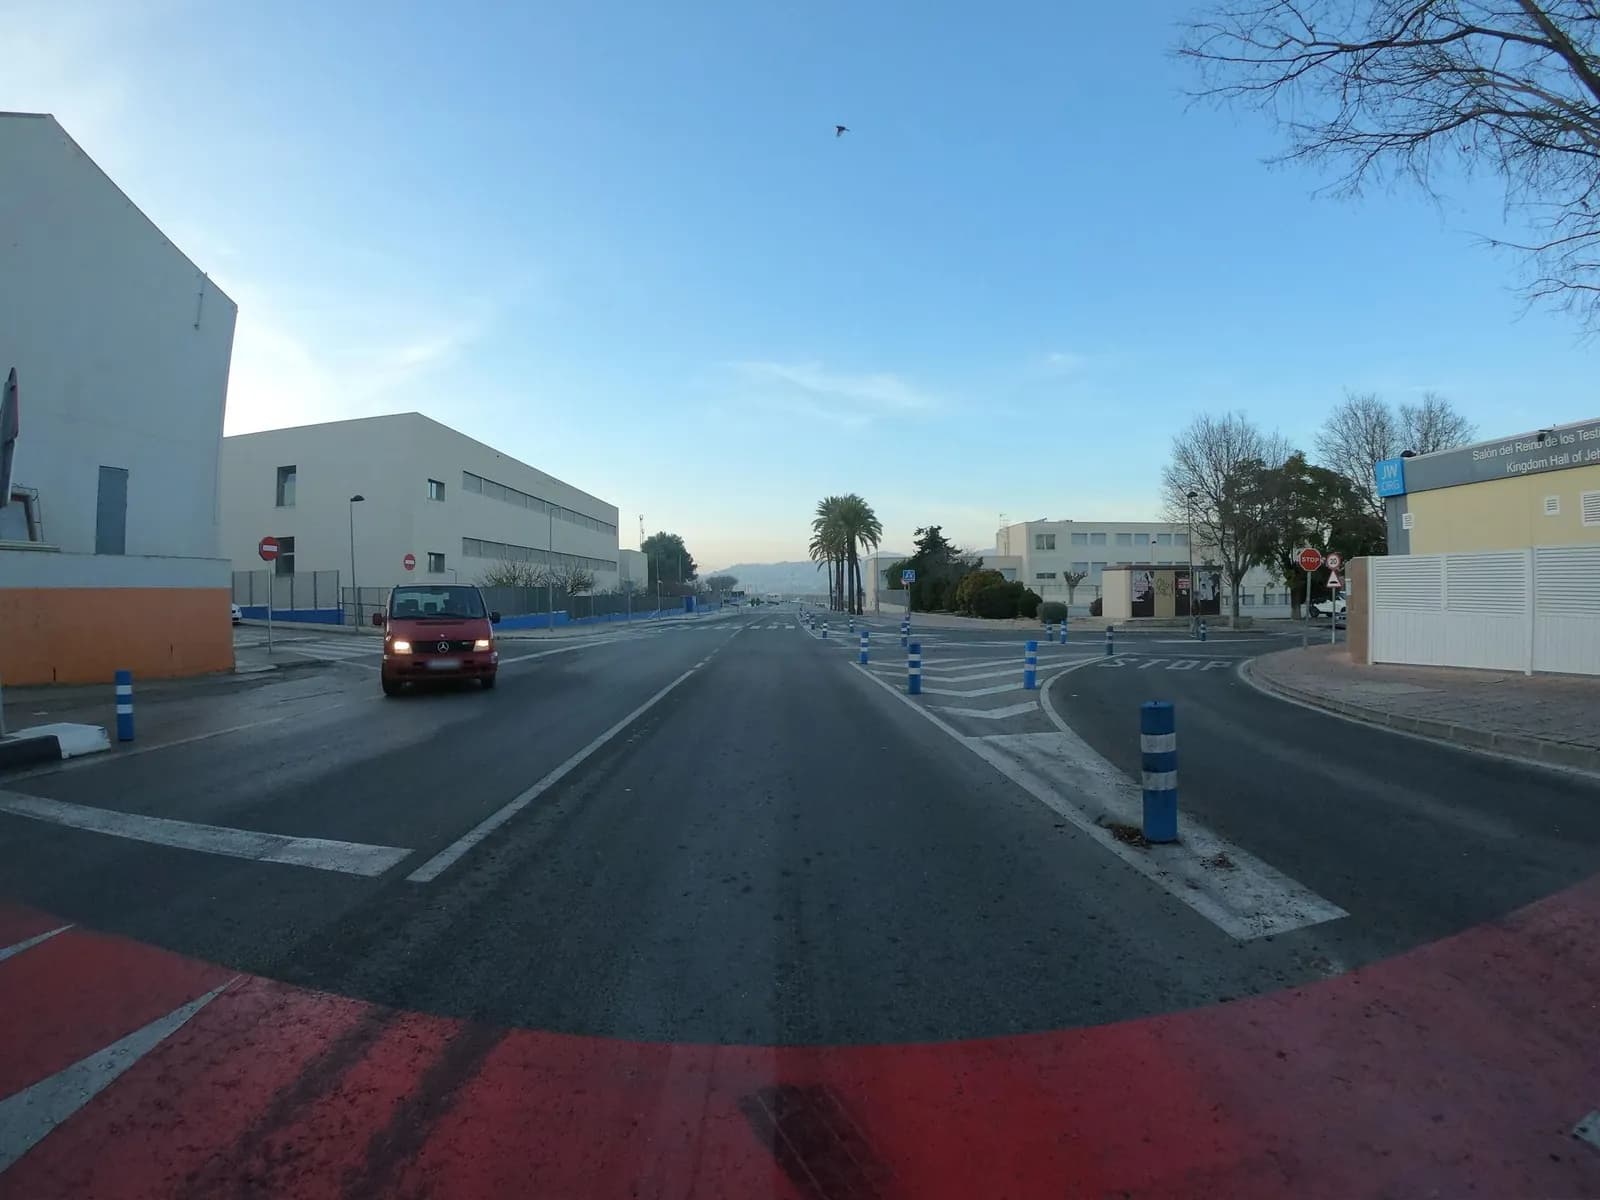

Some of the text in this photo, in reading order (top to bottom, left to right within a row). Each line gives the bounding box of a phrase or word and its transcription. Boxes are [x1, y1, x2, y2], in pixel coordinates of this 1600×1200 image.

[1472, 449, 1498, 461] Salón
[1499, 444, 1513, 456] del
[1514, 440, 1543, 453] Reino
[1545, 436, 1559, 447] de
[1560, 433, 1575, 445] los
[1506, 459, 1548, 474] Kingdom
[1549, 453, 1569, 466] Hall
[1571, 450, 1582, 463] of
[1381, 463, 1398, 479] JW
[1329, 557, 1338, 565] 20
[1097, 658, 1233, 671] STOP
